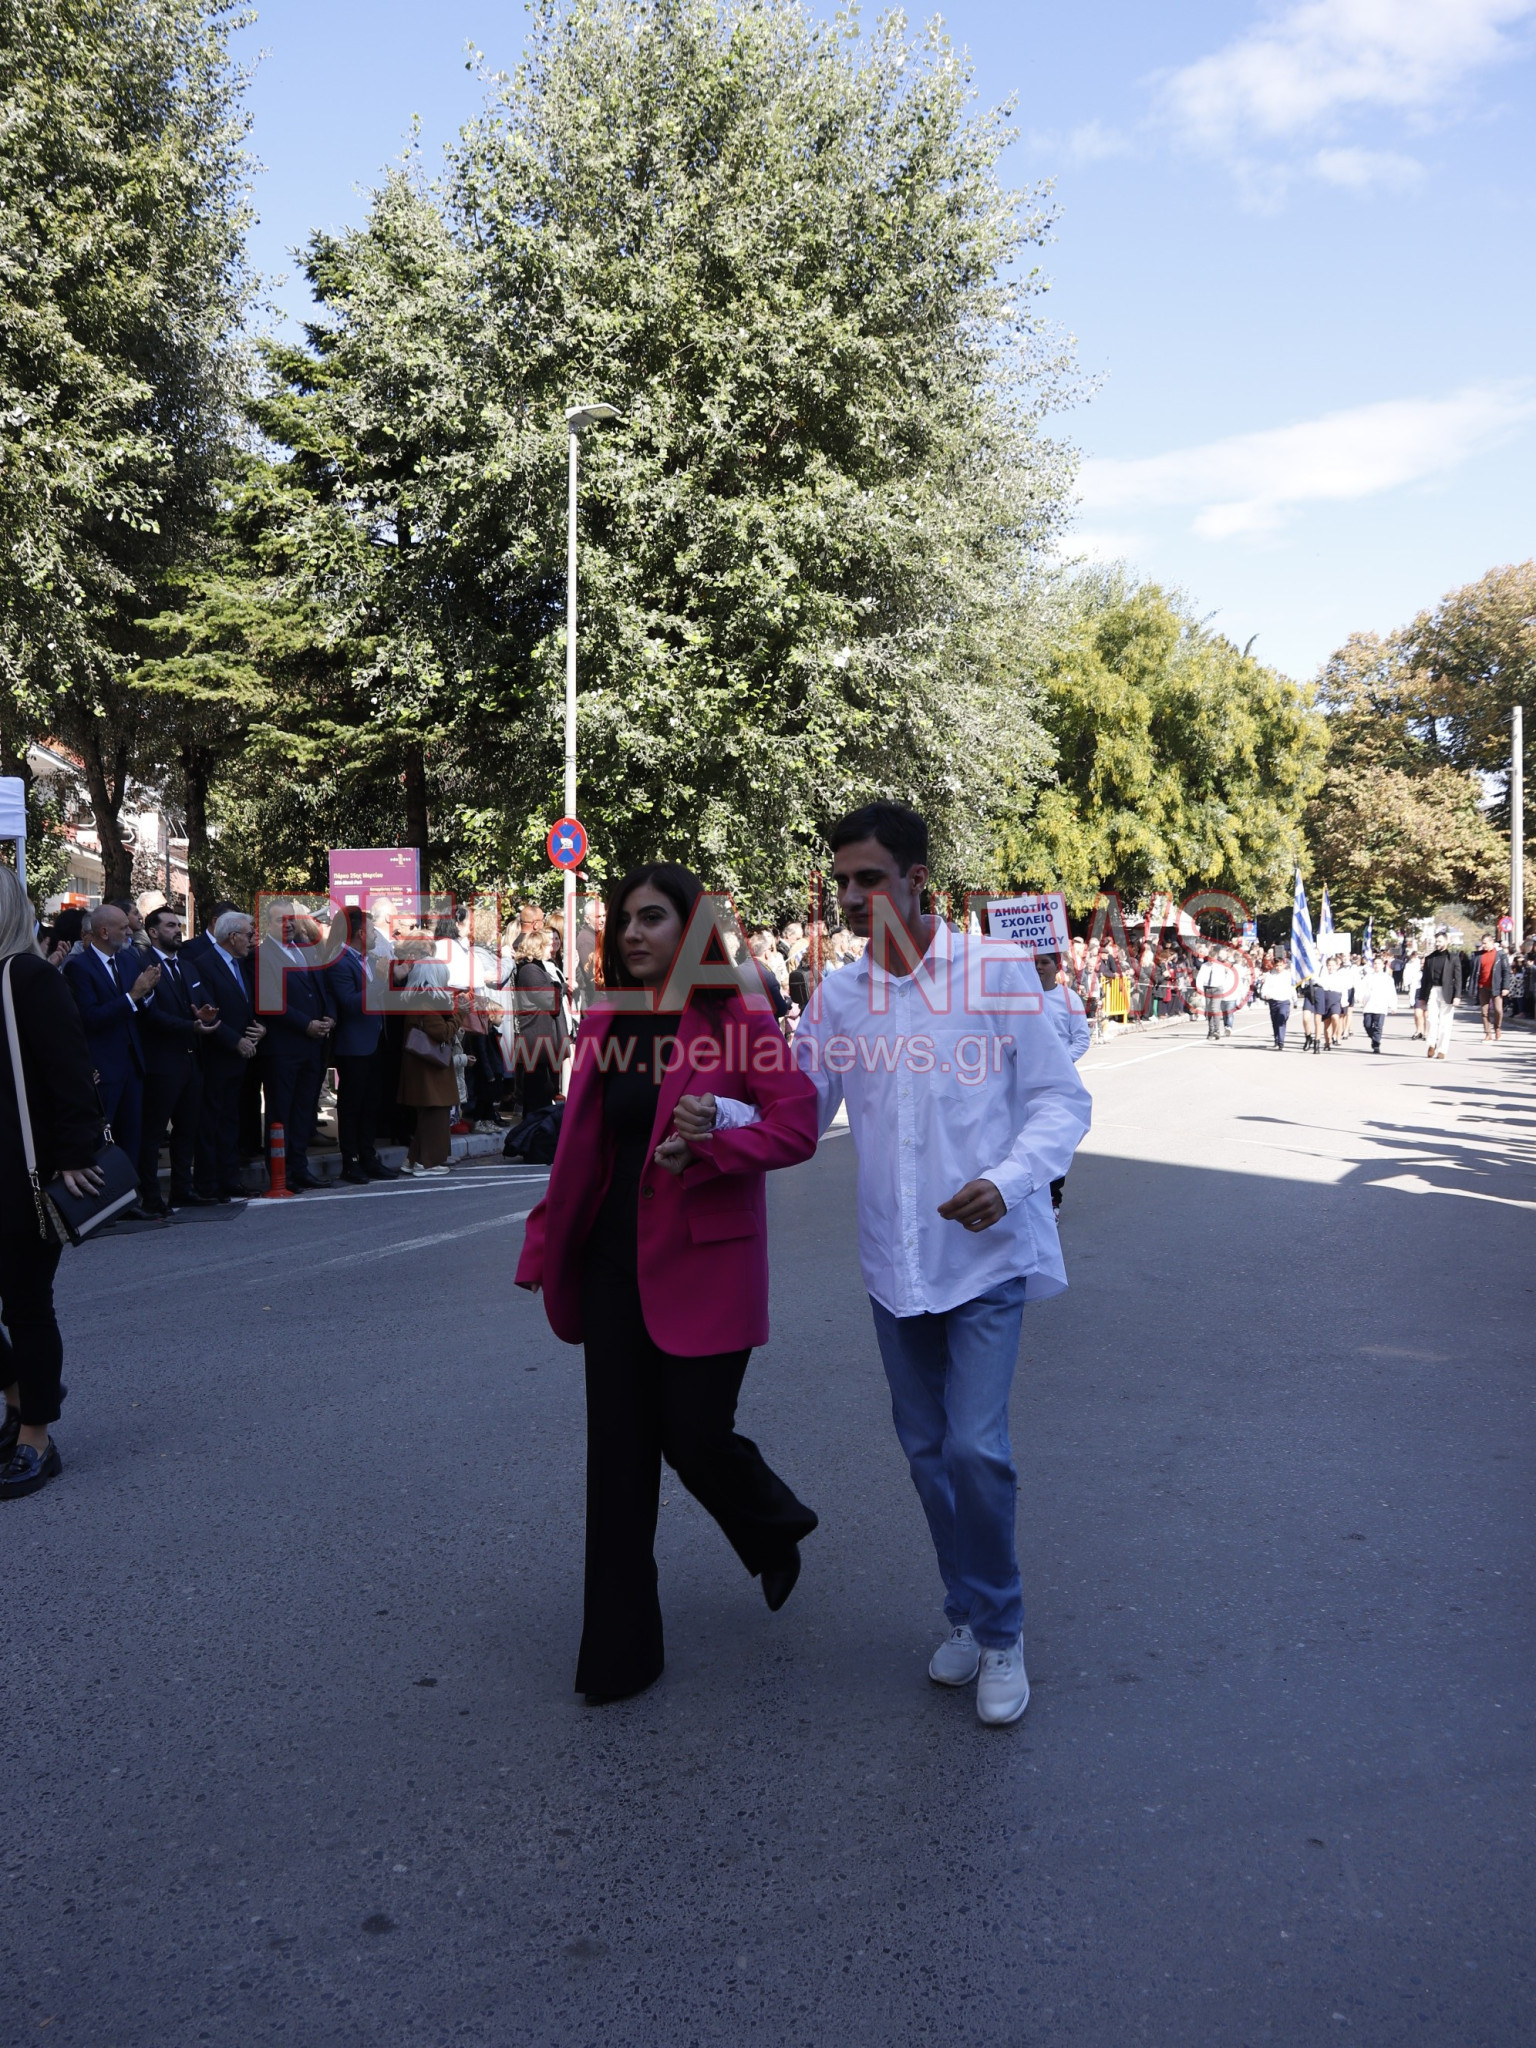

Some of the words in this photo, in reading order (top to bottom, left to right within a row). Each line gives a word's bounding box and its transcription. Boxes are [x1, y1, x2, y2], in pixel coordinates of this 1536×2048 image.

[995, 902, 1058, 917] ΔΗΜΟΤΙΚΟ
[1001, 914, 1053, 928] ΣΧΟΛΕΙΟ
[1011, 927, 1046, 938] ΑΓΙΟΥ
[1014, 936, 1064, 948] ΝΑΣΙΟΥ
